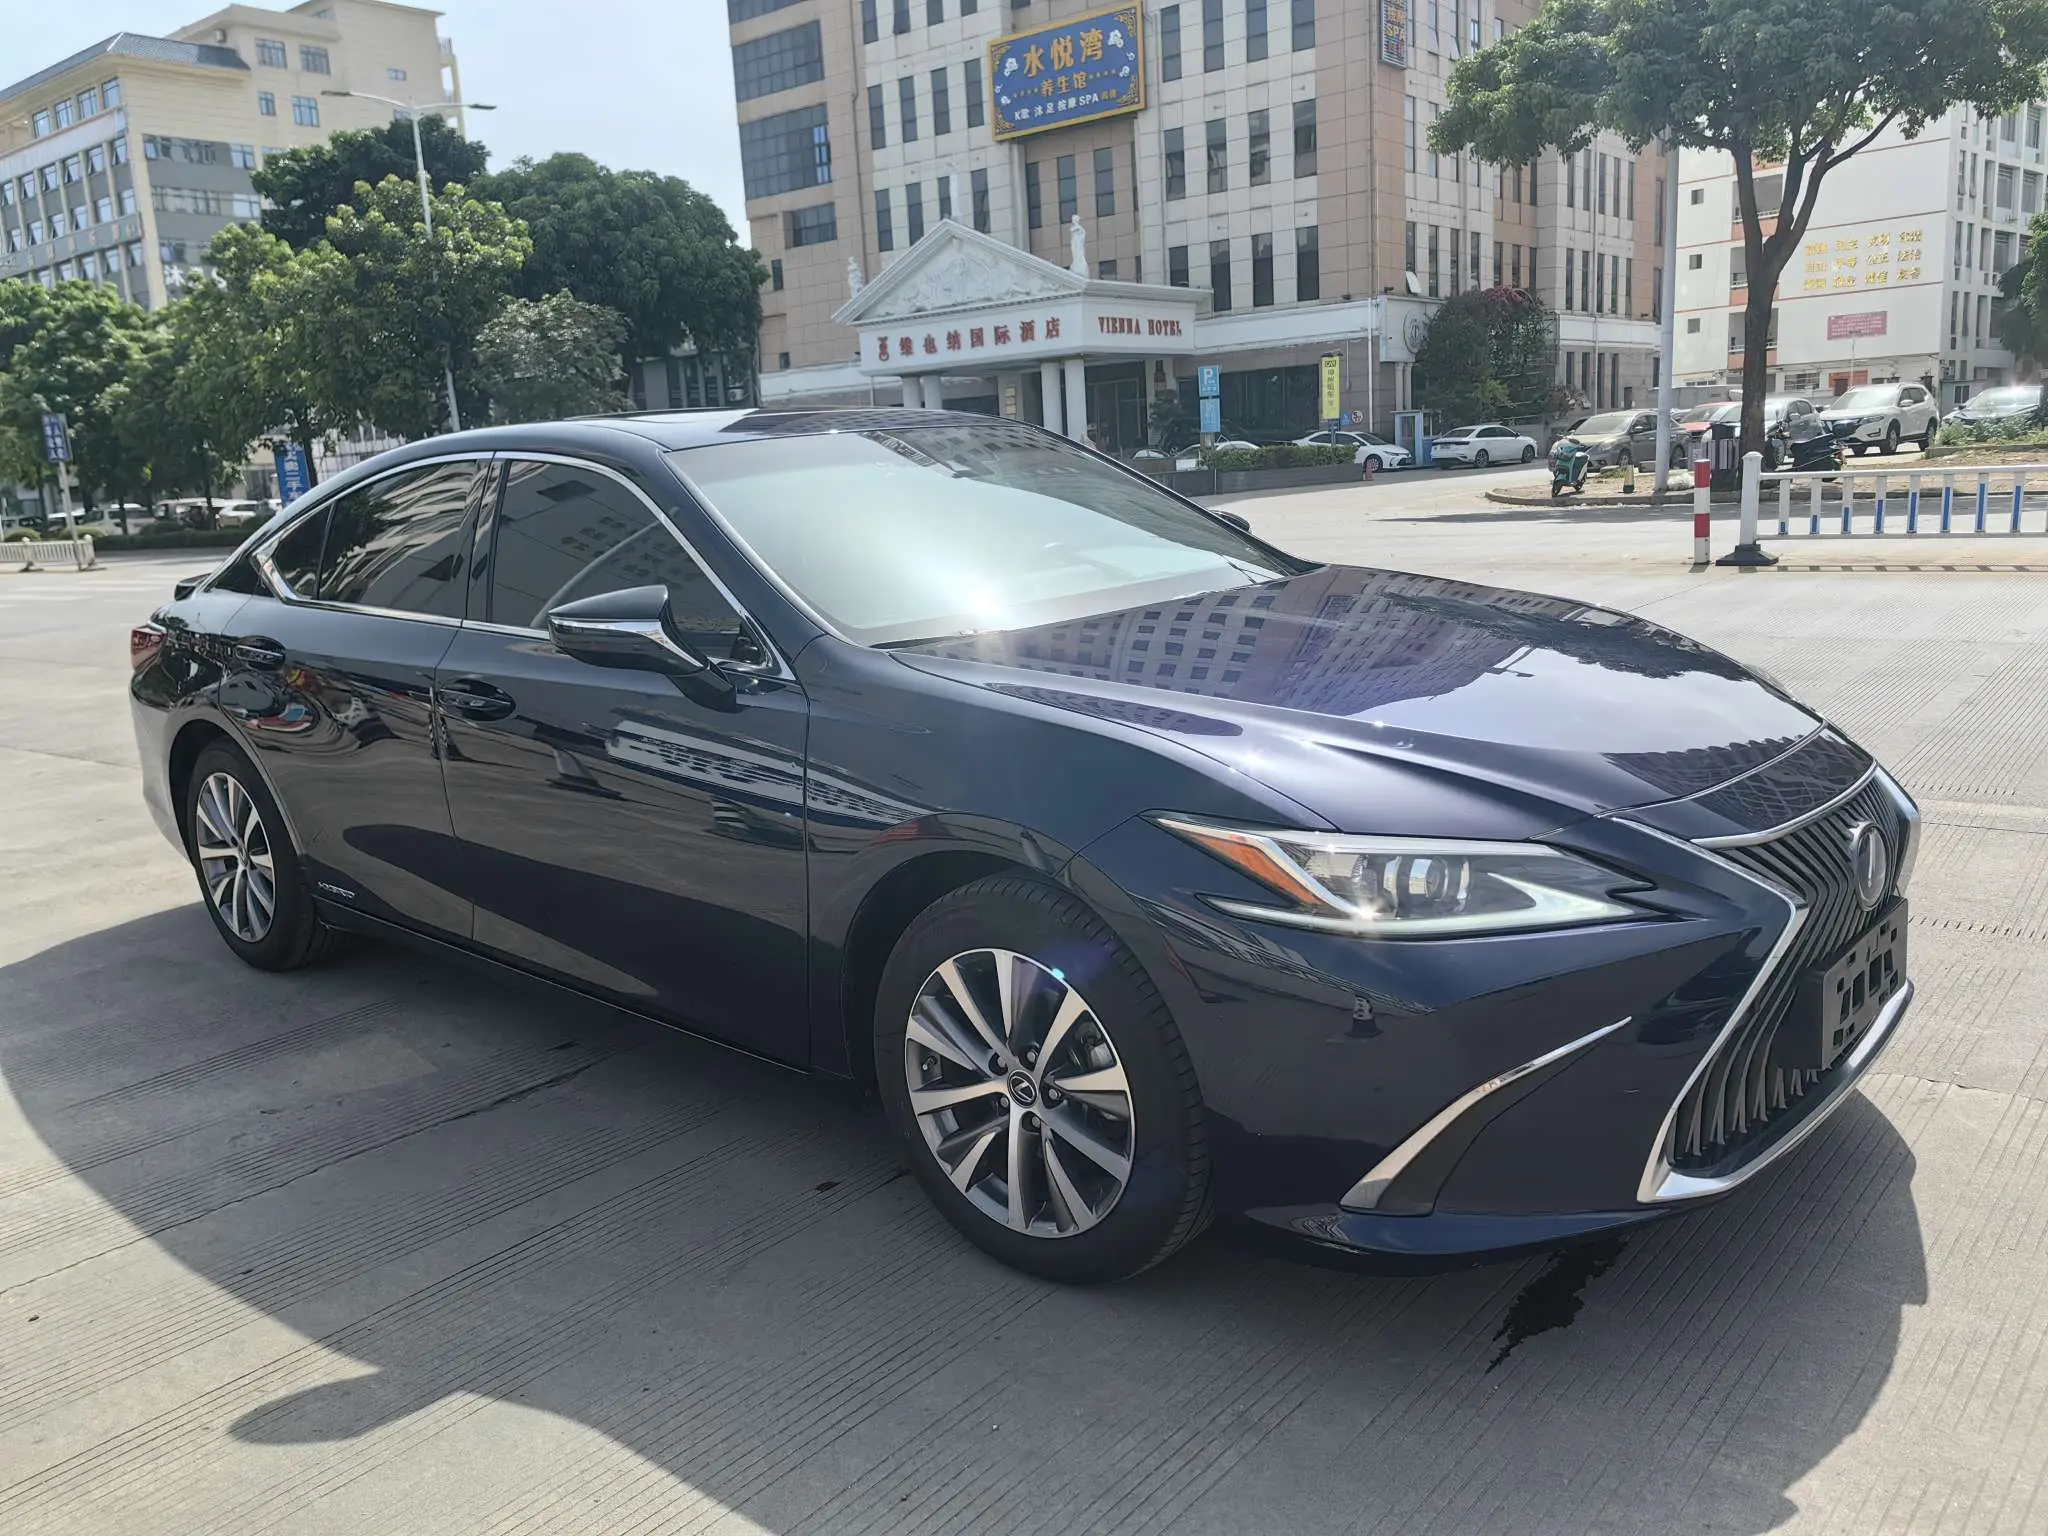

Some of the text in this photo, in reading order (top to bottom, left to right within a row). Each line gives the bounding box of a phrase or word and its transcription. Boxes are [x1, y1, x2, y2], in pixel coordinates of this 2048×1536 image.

[1023, 28, 1104, 77] 水悦湾
[1041, 72, 1087, 97] 养生馆
[1079, 92, 1099, 106] SPA
[899, 317, 1060, 356] 维也纳国际酒店
[1098, 316, 1182, 336] VIENNA HOTEL
[1204, 368, 1214, 385] P
